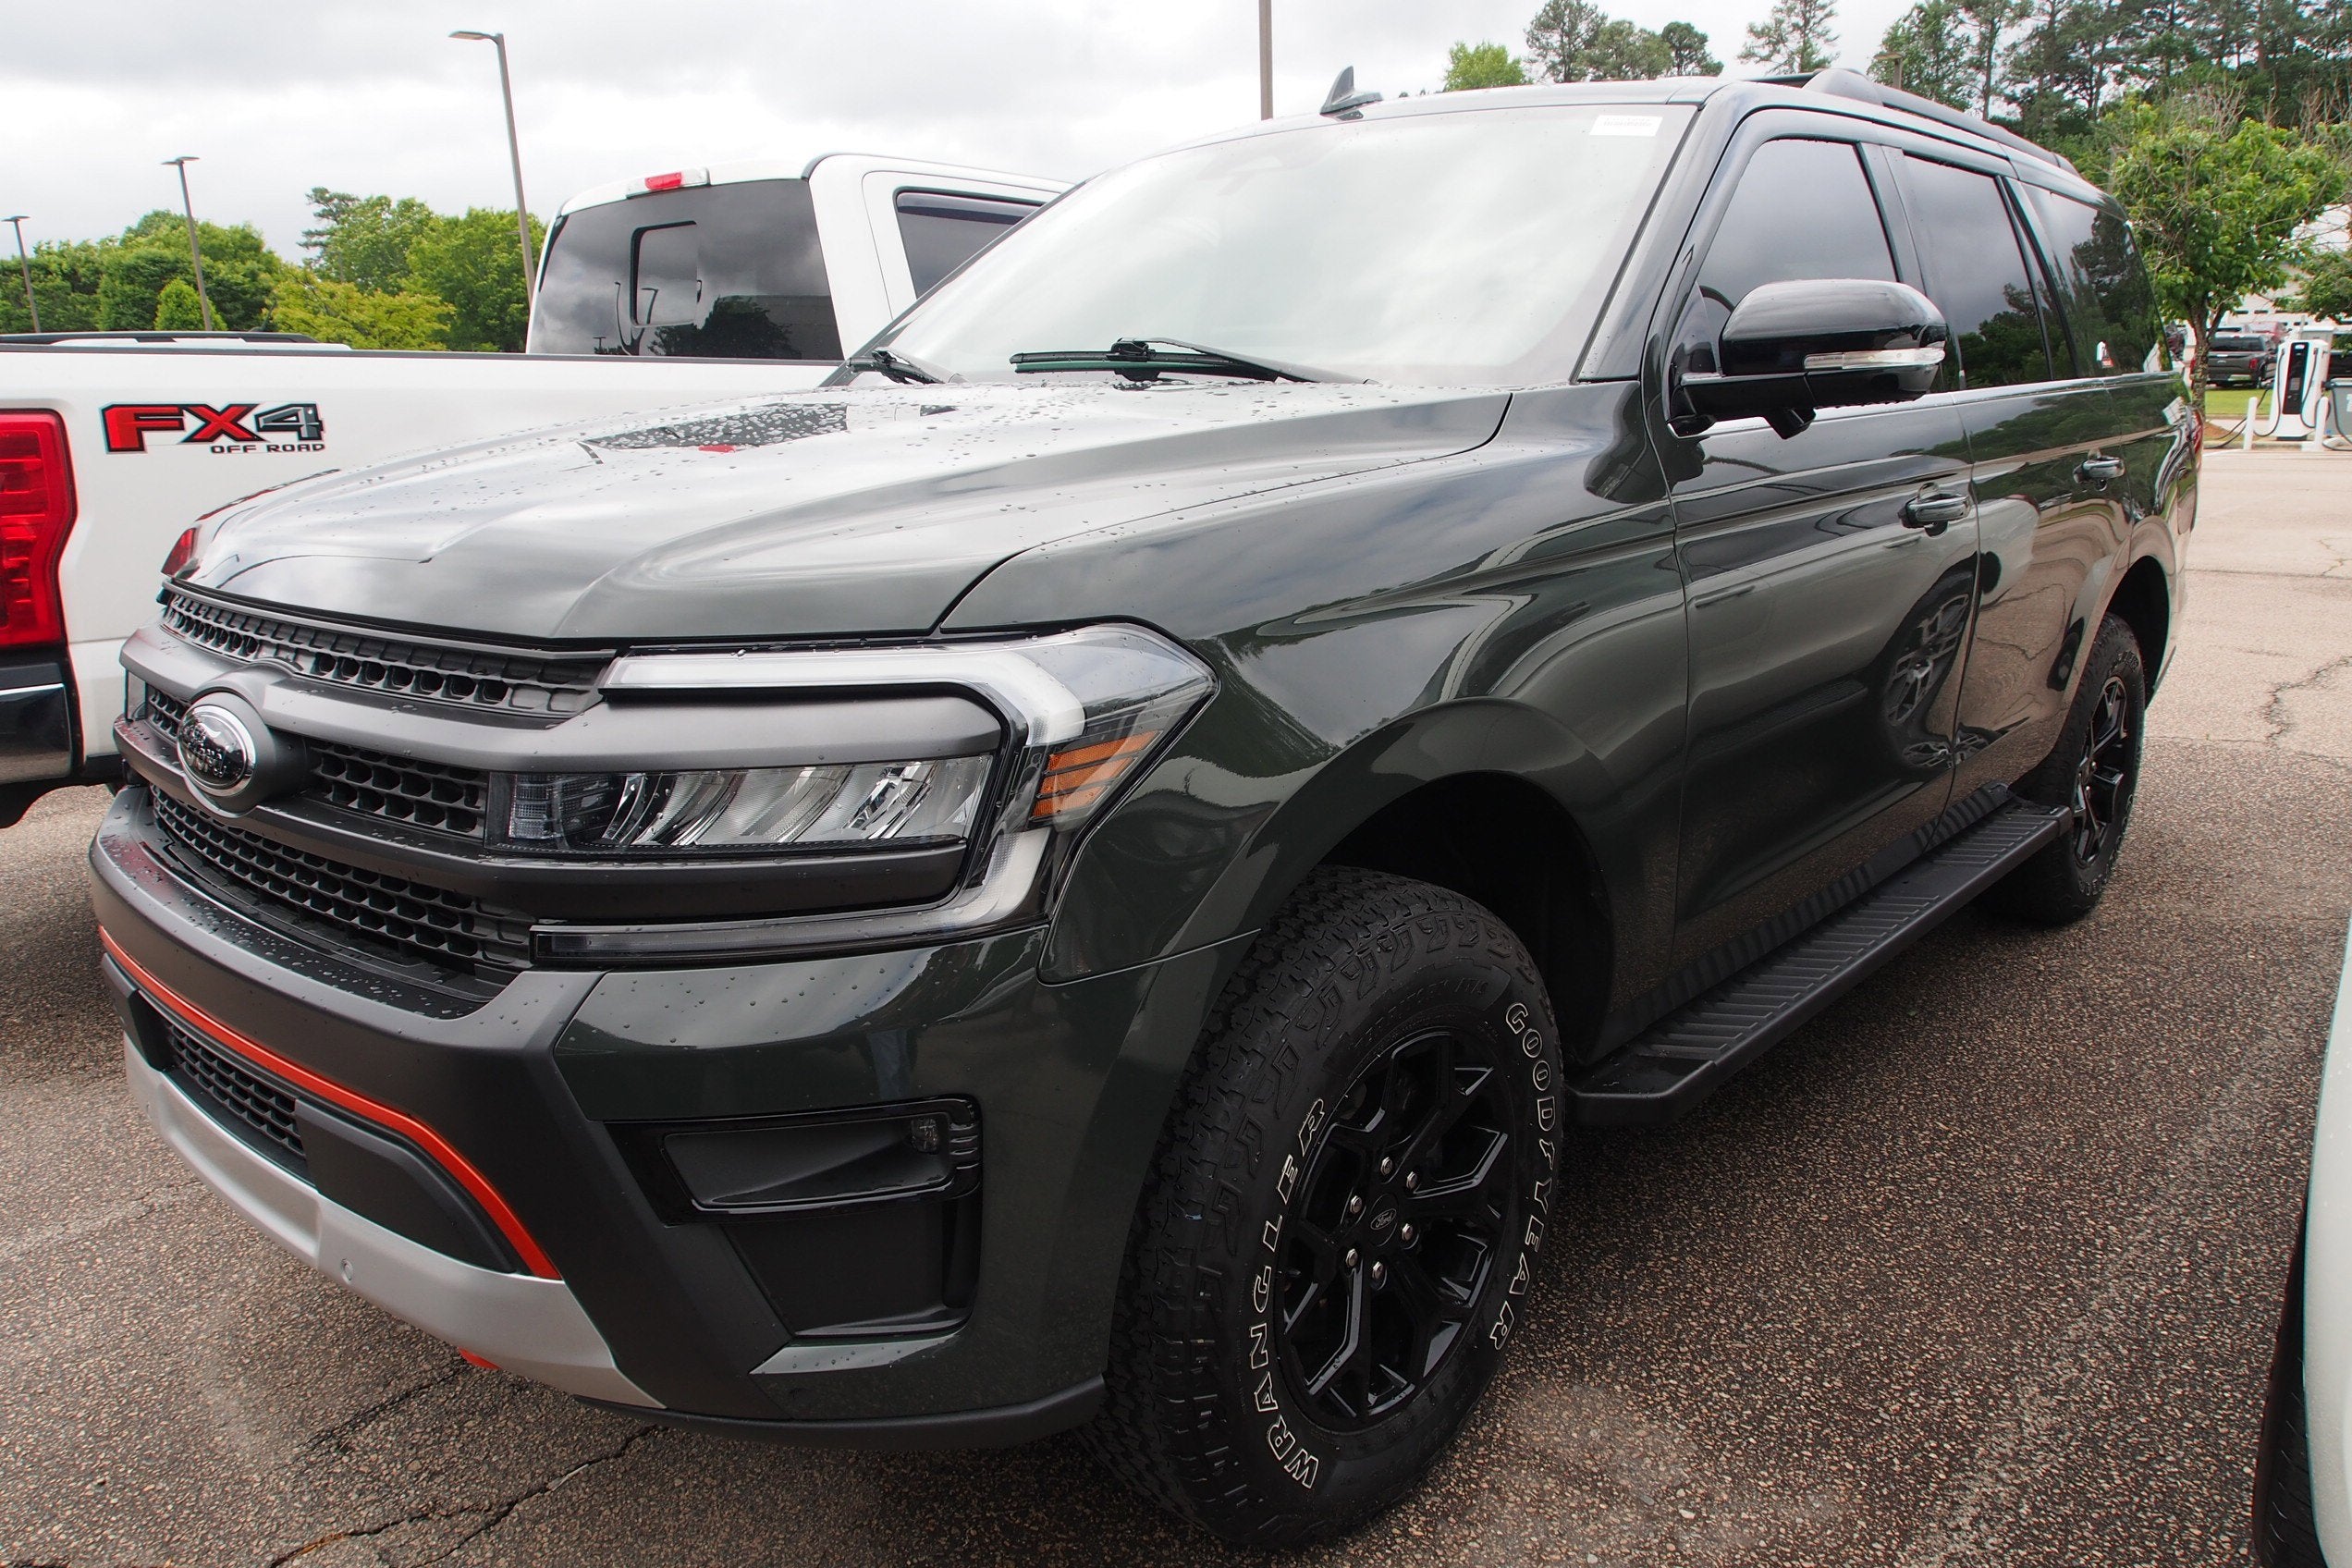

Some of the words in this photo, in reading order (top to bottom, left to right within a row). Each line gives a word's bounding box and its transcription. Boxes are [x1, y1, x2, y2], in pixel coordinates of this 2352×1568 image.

[100, 403, 324, 452] FX4
[211, 445, 257, 454] OFF
[266, 443, 325, 453] ROAD
[1489, 1002, 1556, 1351] GOODYEAR
[1250, 1098, 1326, 1489] WRANGLER
